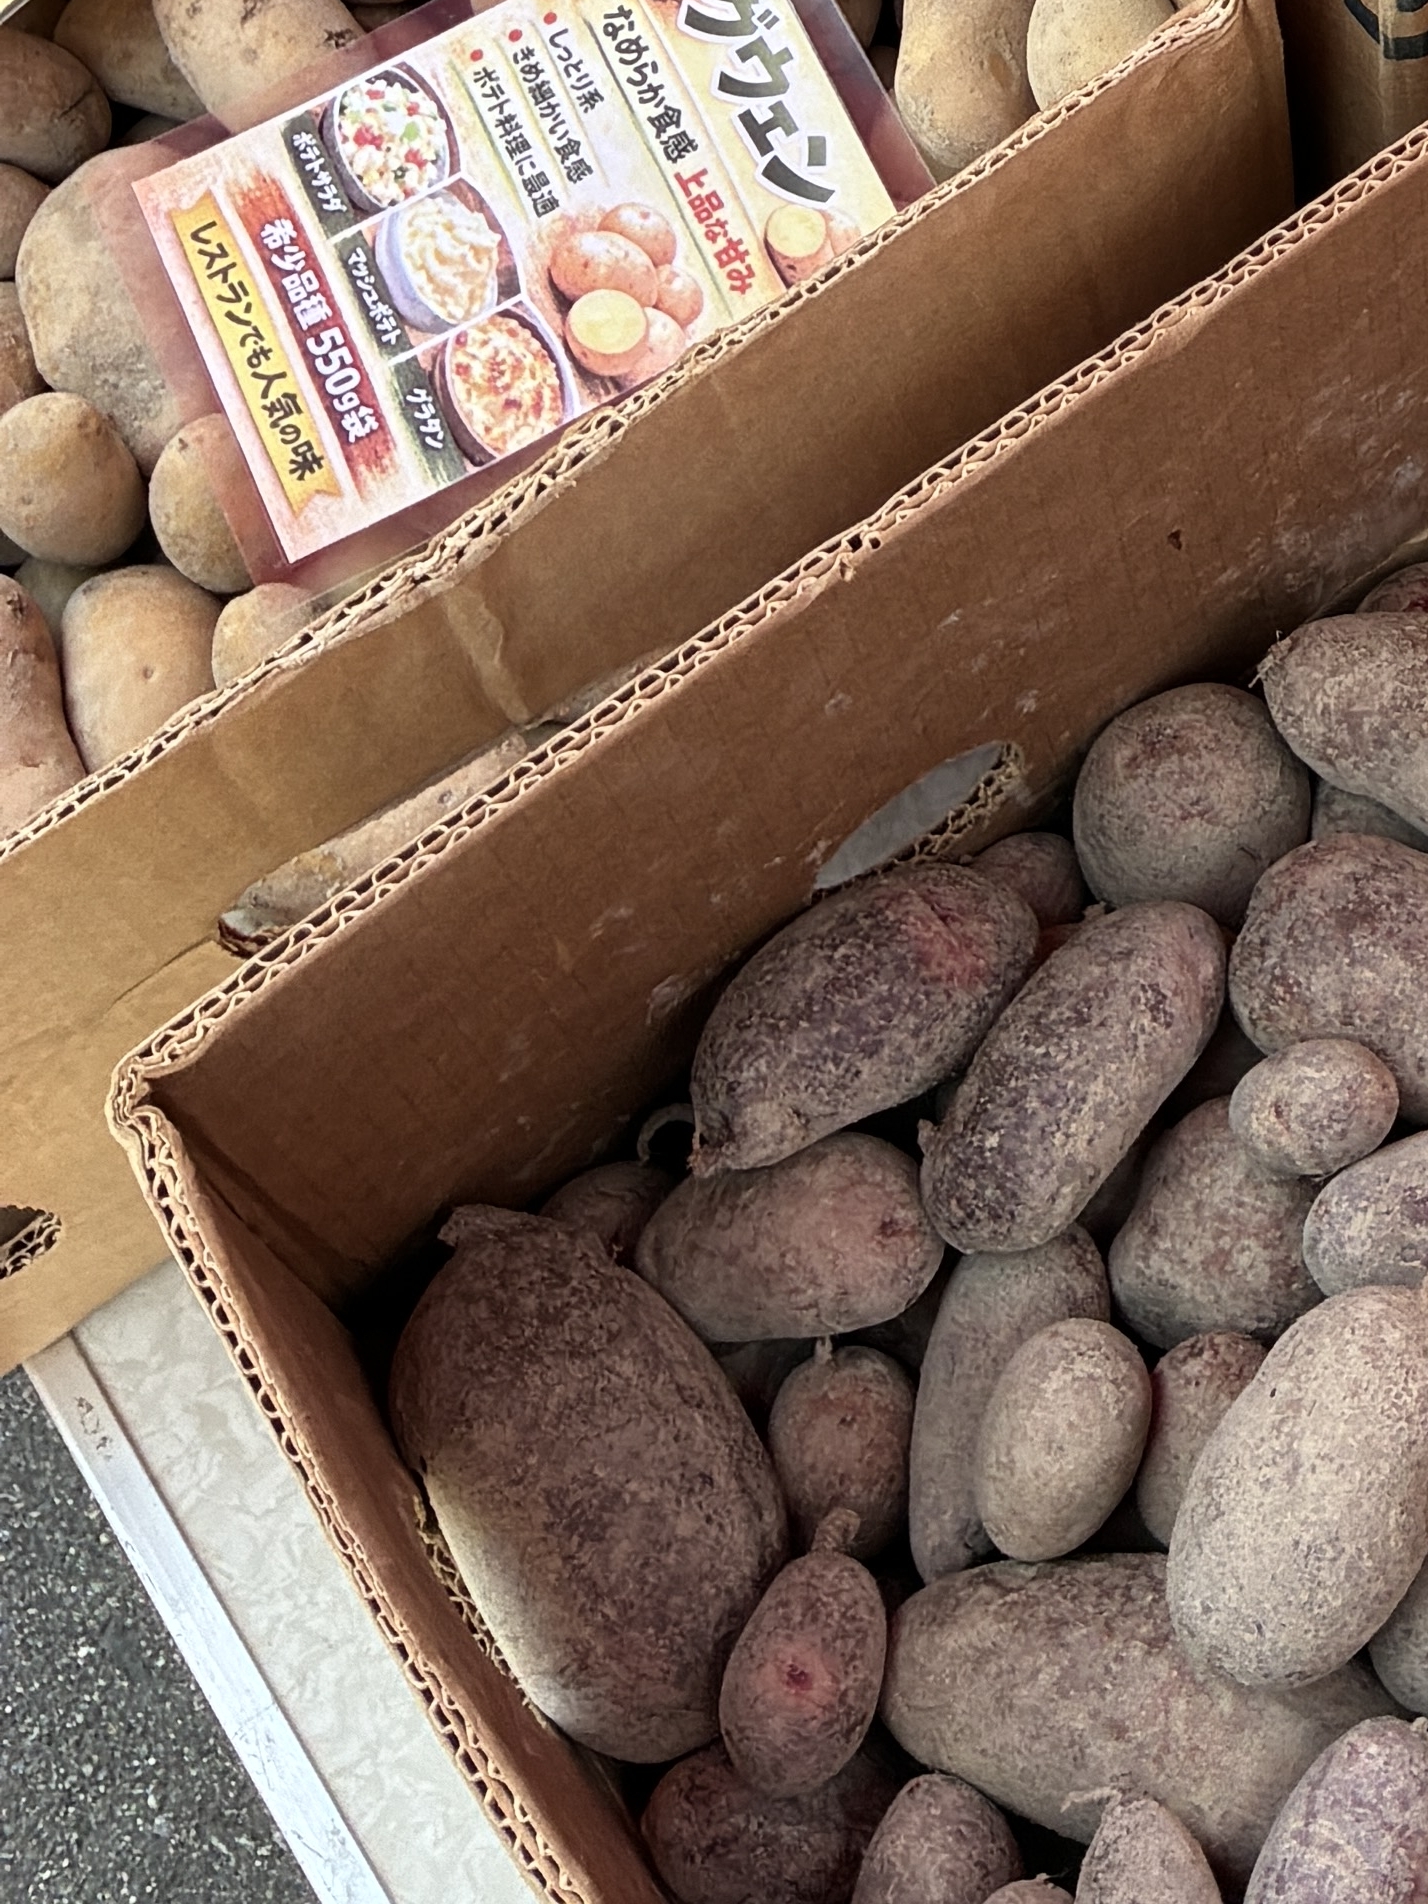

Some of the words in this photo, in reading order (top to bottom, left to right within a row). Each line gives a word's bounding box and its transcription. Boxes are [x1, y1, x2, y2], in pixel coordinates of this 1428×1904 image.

[510, 44, 594, 186] きめ細かい食感
[546, 27, 605, 116] しっとり系
[292, 130, 349, 215] ポテトサラダ
[472, 66, 564, 220] ポテト料理に最適
[601, 4, 701, 166] なめらか食感
[673, 167, 757, 297] 上品な甘み
[188, 220, 326, 484] レストランでも人気の味
[259, 217, 335, 331] 希少品種
[304, 327, 380, 444] 550g袋
[346, 246, 400, 347] マッシュポテト
[404, 385, 446, 450] グラタン
